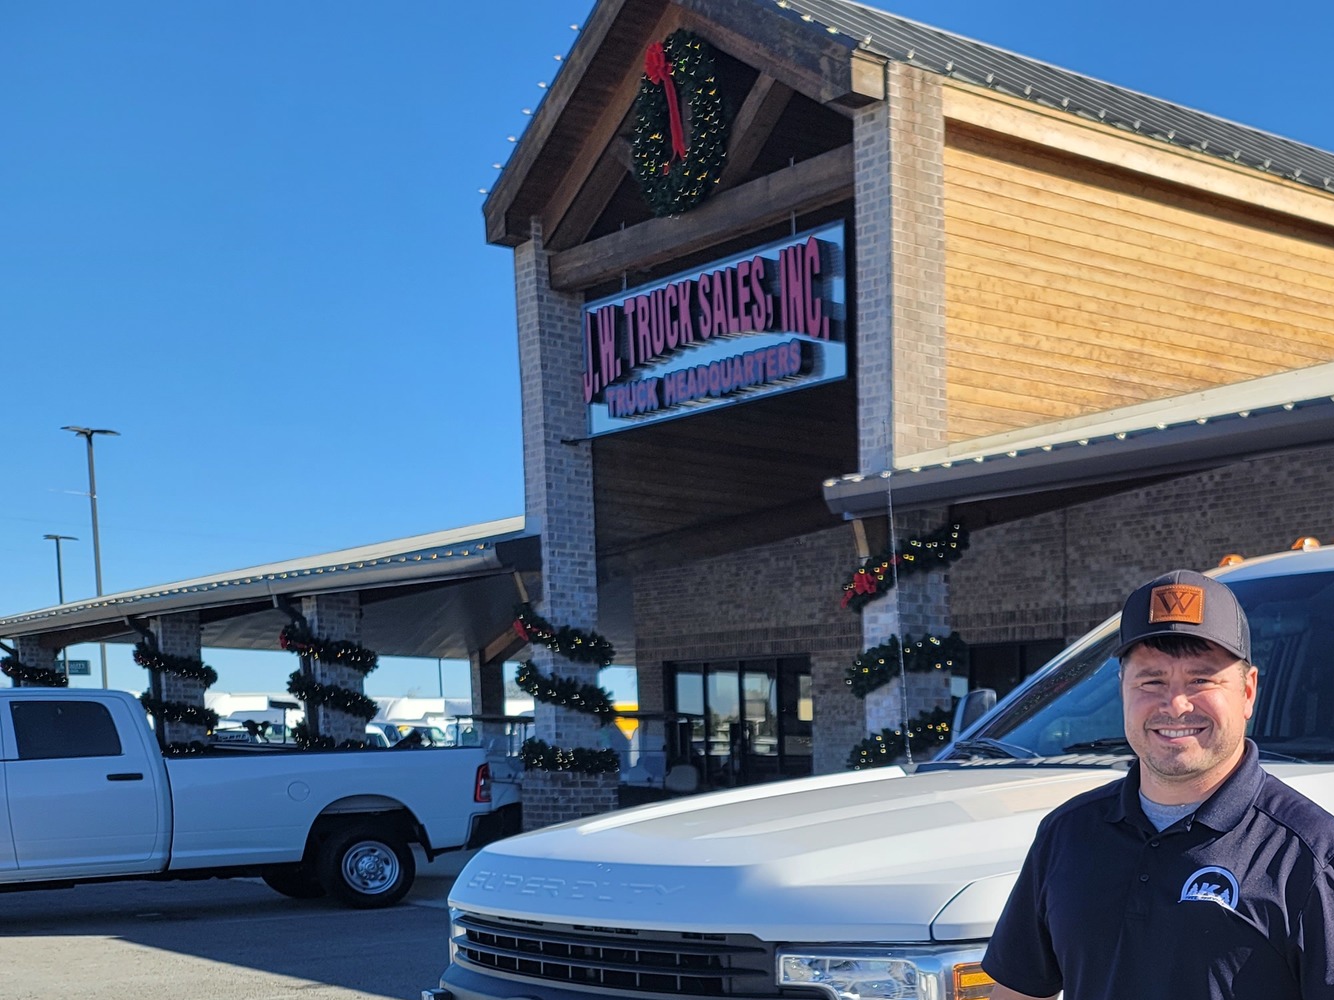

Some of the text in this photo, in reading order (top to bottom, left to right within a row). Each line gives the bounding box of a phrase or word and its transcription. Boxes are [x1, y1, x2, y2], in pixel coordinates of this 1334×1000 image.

[624, 279, 694, 367] TRUCK
[699, 256, 773, 338] SALES,
[779, 236, 830, 340] INC.
[605, 338, 801, 418] TRUCK HEADQUARTERS
[1156, 592, 1198, 614] W
[467, 871, 566, 897] SUPER
